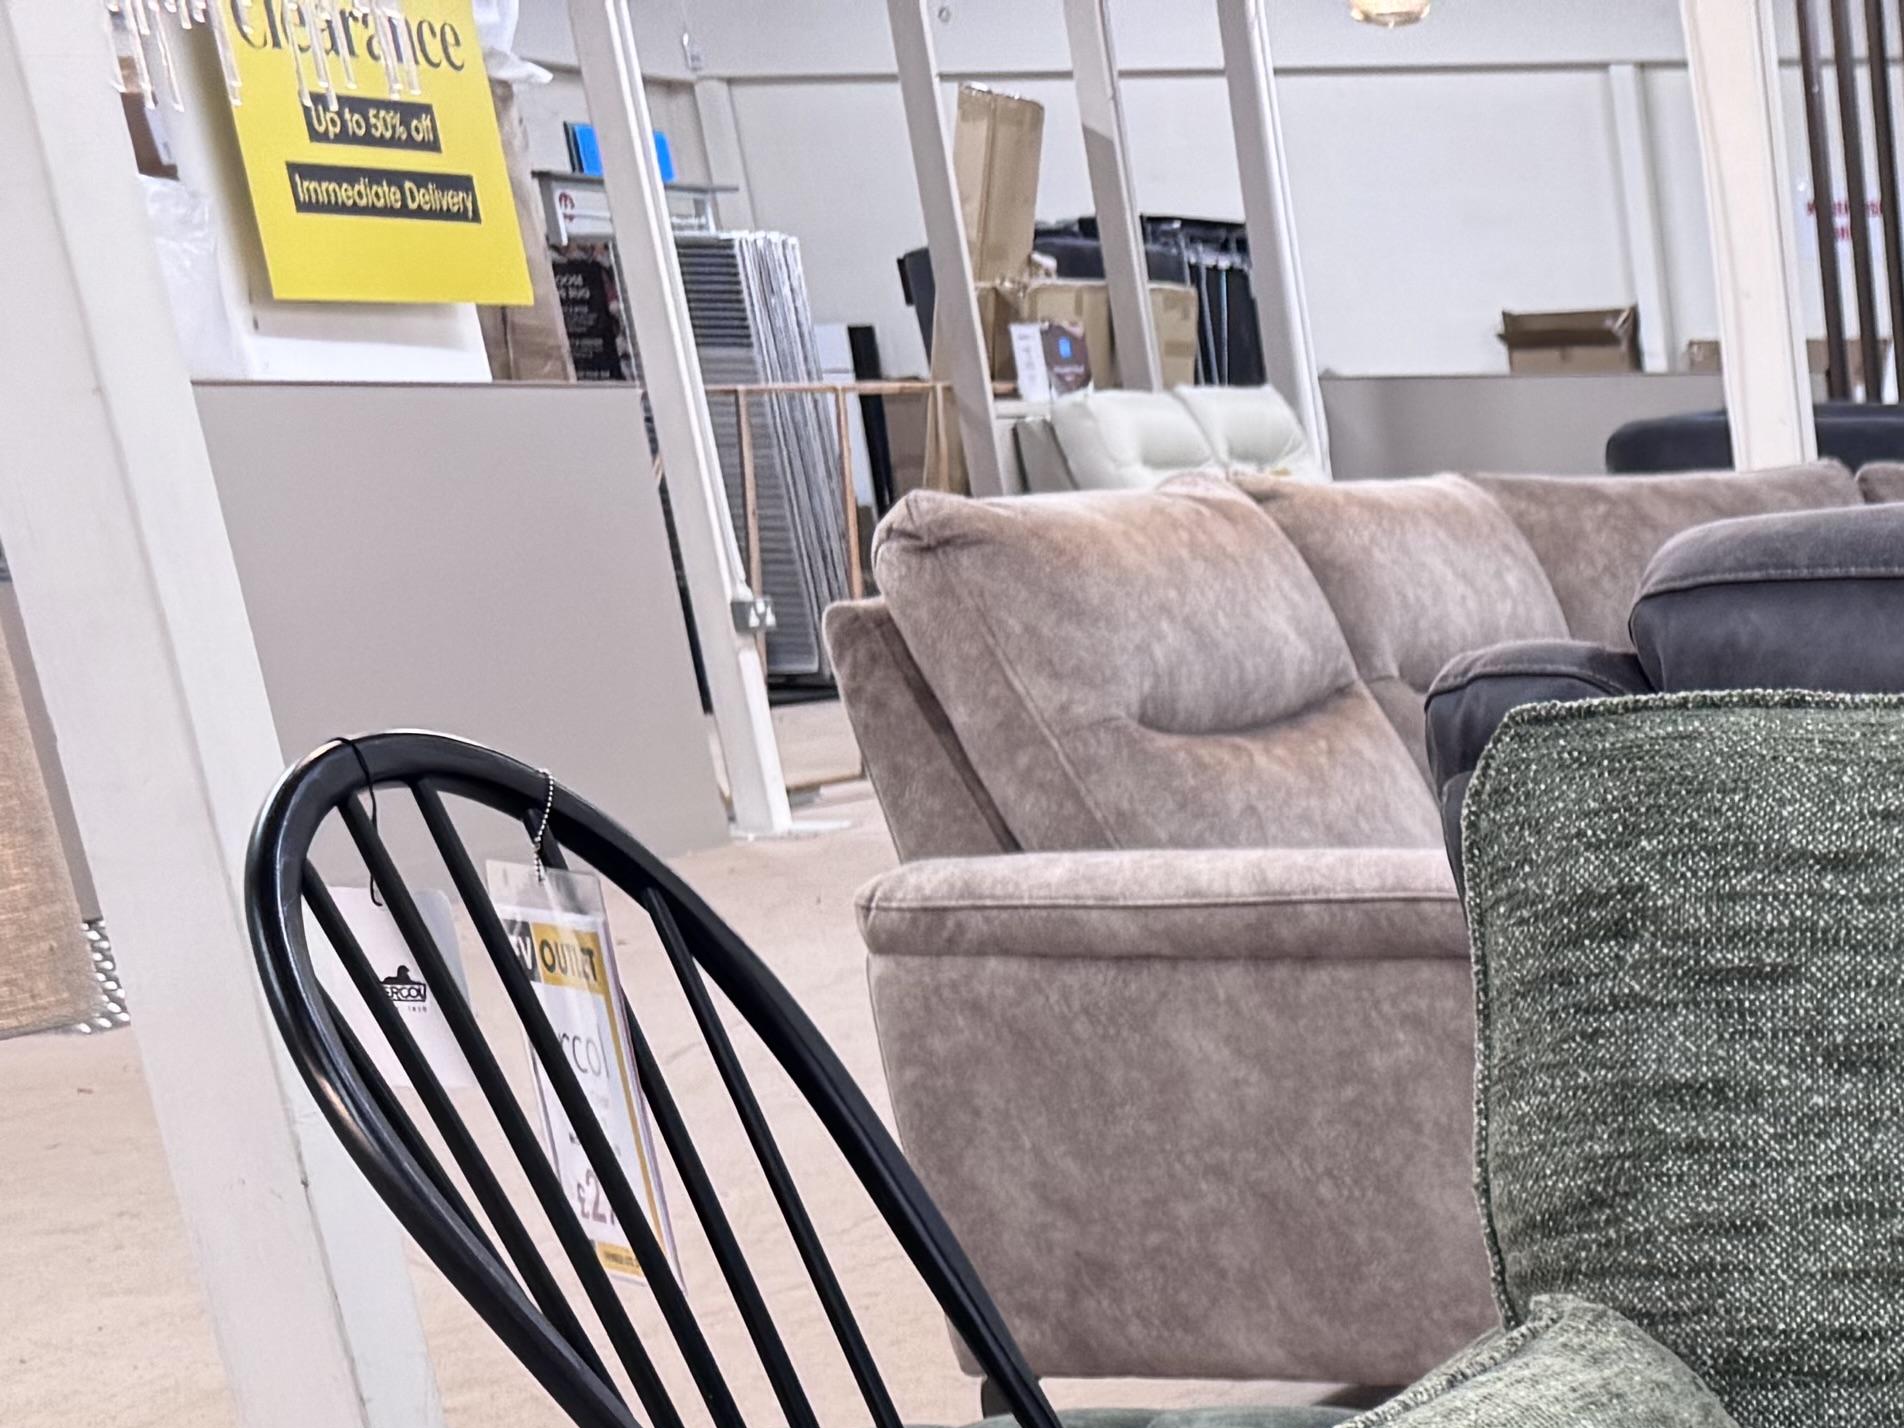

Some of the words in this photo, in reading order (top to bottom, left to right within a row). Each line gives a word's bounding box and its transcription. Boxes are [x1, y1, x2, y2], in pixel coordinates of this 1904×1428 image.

[311, 104, 341, 139] Up
[344, 107, 366, 136] to
[367, 107, 407, 141] 50%
[410, 114, 435, 142] off
[294, 173, 402, 209] Immediate
[404, 180, 474, 219] Delivery
[558, 1022, 610, 1079] rcol
